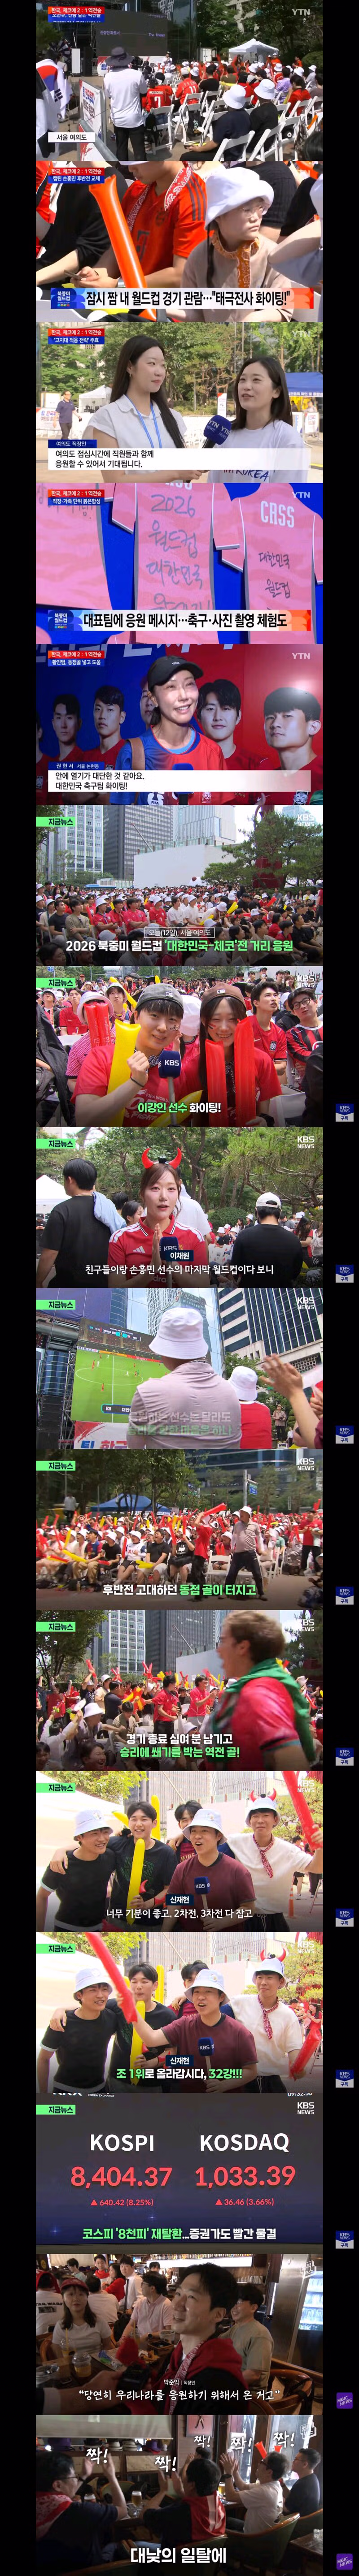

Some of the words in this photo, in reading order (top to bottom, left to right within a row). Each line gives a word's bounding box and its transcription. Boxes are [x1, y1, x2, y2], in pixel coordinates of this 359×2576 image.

[154, 96, 161, 108] 7
[209, 419, 220, 428] YTN
[151, 494, 196, 518] 2026
[261, 501, 295, 528] CASS
[148, 519, 198, 559] 월드컵
[258, 551, 290, 570] 대한민국
[146, 559, 203, 590] 대한민국
[265, 579, 291, 599] 월드컵
[91, 2134, 154, 2152] KOSPI
[200, 2133, 289, 2152] KOSDAQ
[71, 2166, 172, 2188] 8,404.37
[195, 2165, 296, 2188] 1,033.39
